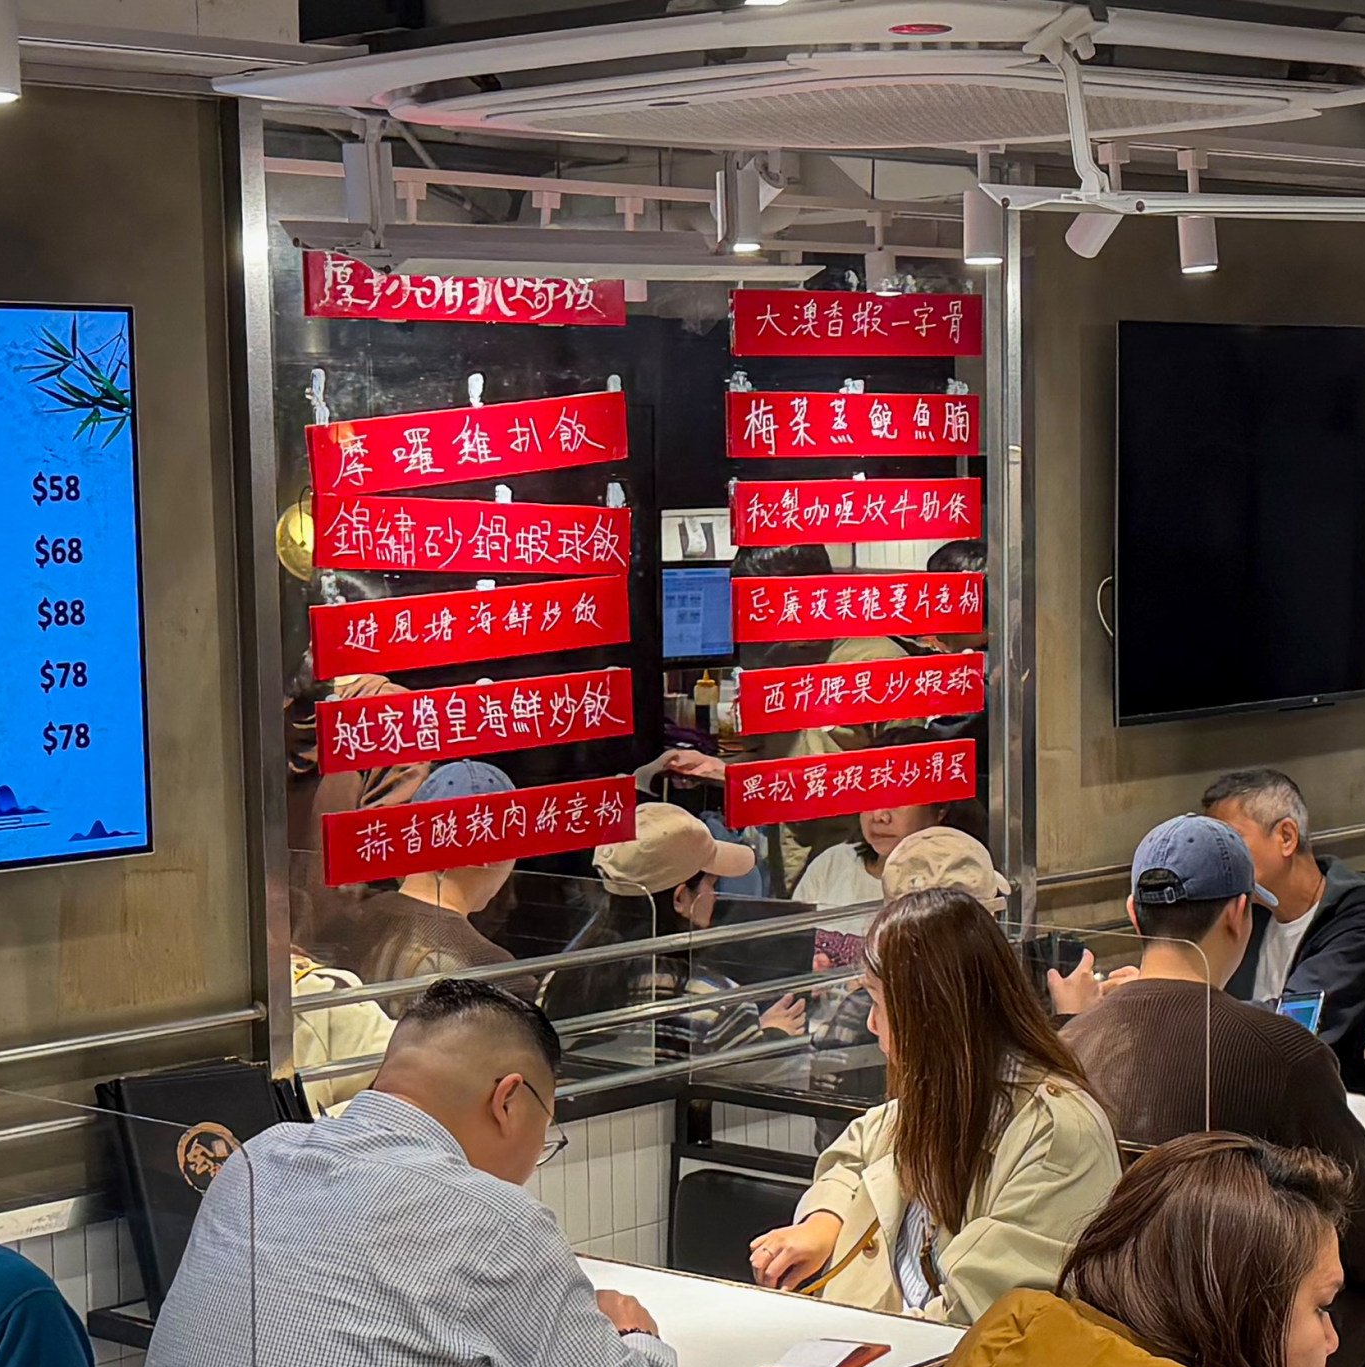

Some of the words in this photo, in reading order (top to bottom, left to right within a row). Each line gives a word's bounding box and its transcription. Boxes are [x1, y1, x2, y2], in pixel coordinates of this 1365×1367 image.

[756, 298, 963, 344] 大澳香蝦一字骨
[32, 471, 81, 506] $58
[35, 534, 83, 568] $68
[37, 597, 85, 631] $88
[345, 592, 603, 653] 避風塘海鮮炒飯
[40, 660, 88, 693] $78
[764, 665, 974, 714] 西芹腰果炒蝦球
[43, 721, 91, 756] $78
[743, 752, 969, 802] 黑松露蝦球炒滑蛋
[356, 790, 624, 862] 蒜香酸辣肉絲意粉
